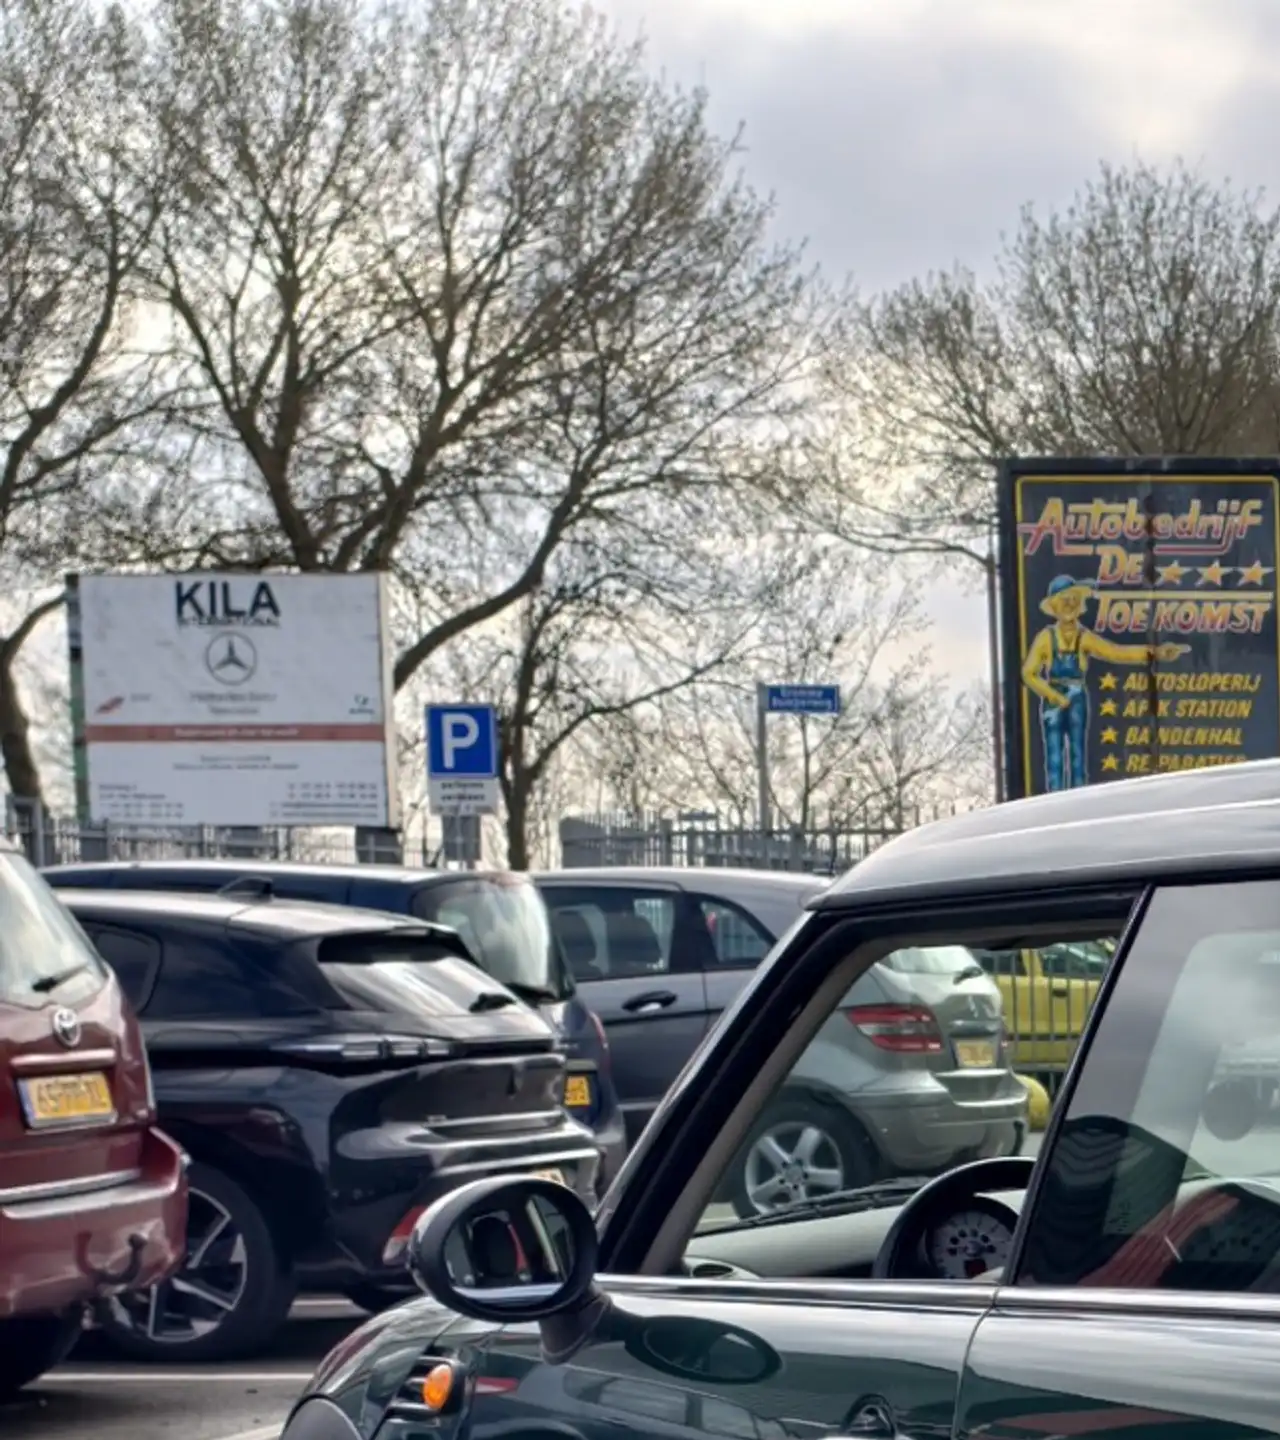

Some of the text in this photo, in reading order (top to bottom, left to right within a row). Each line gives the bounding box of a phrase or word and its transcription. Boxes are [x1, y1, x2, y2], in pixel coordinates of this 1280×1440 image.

[1017, 497, 1263, 556] Autobedrijf
[176, 580, 281, 617] KILA
[1093, 590, 1274, 634] TOEKOMST
[1123, 672, 1262, 693] AUTOSLOPERIJ
[1175, 699, 1252, 718] STATION
[441, 712, 480, 769] P
[1124, 727, 1243, 746] BANDENHAL
